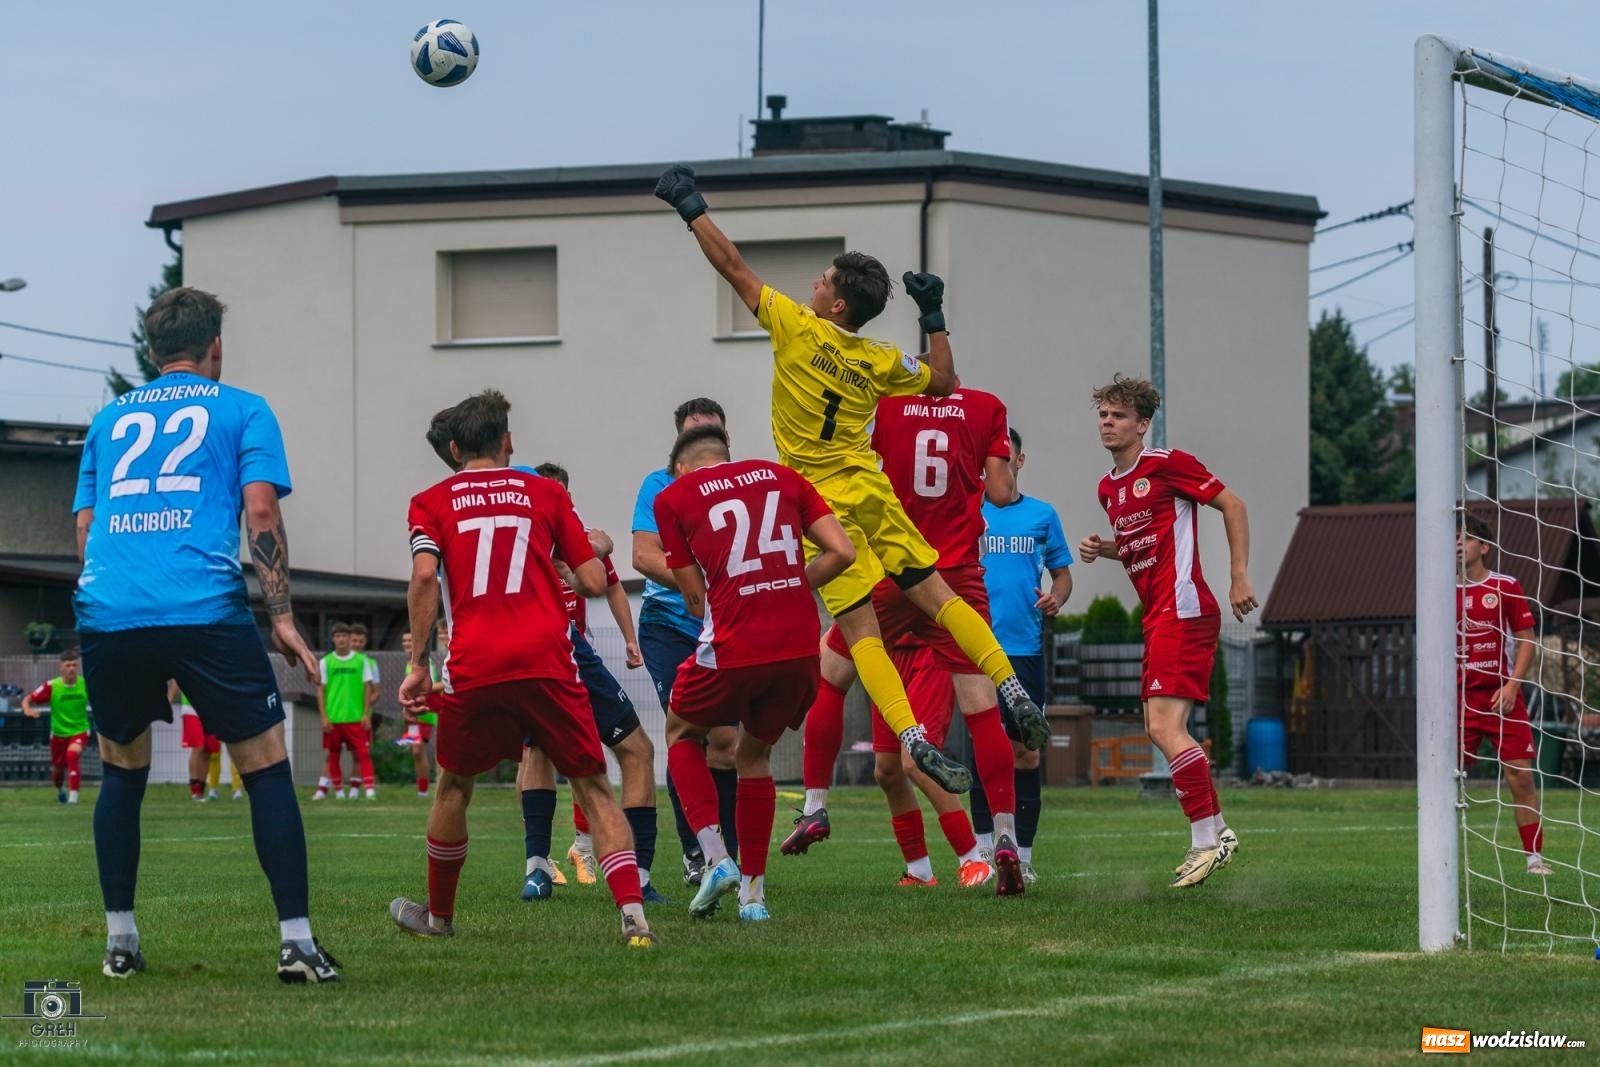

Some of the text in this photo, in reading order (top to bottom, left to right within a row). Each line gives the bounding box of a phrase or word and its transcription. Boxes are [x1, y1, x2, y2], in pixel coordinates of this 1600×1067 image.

[810, 353, 839, 379] UNIA
[116, 384, 220, 406] STUDZIENNA
[818, 388, 844, 442] 1
[903, 403, 966, 420] UNIA TURZA
[109, 404, 210, 500] 22
[913, 428, 950, 498] 6
[698, 468, 779, 497] UNIA TURZA
[451, 491, 533, 512] UNIA TURZA
[108, 506, 194, 535] RACIBÓRZ
[707, 490, 799, 579] 24
[456, 514, 533, 599] 77
[738, 576, 803, 597] GROS
